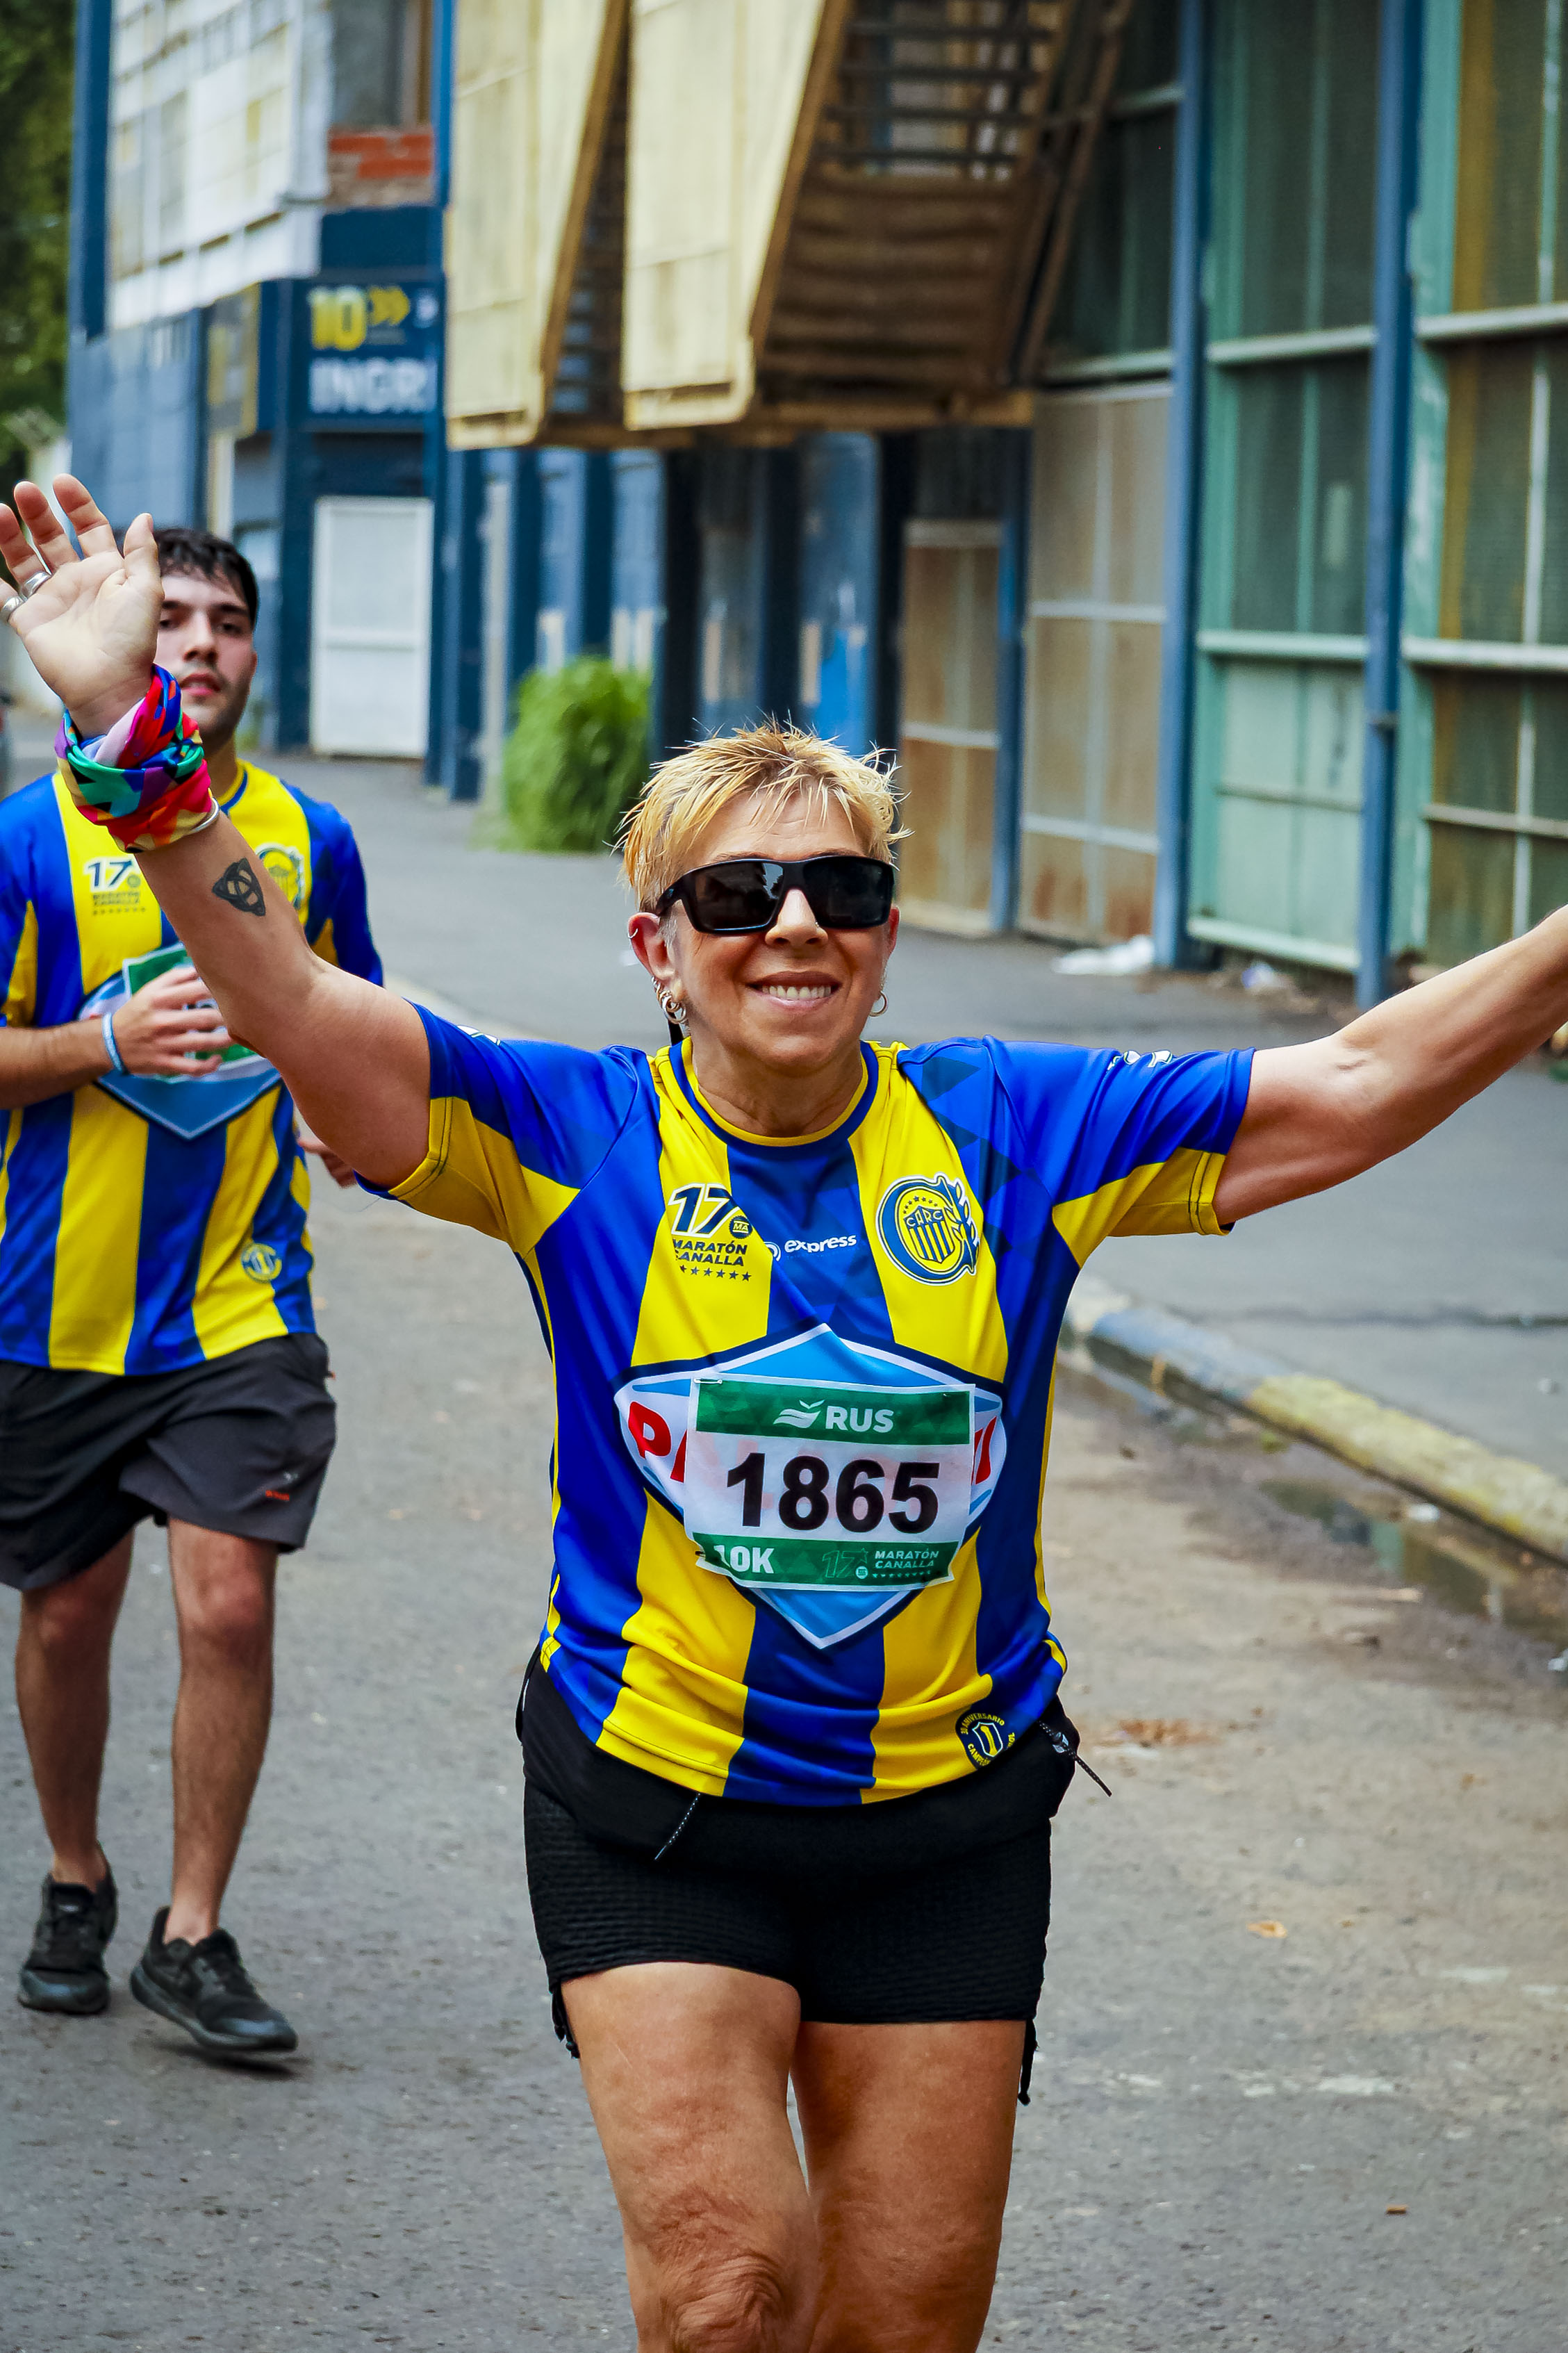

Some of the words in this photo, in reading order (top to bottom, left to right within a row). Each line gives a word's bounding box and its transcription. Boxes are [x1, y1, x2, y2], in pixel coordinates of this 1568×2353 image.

[309, 286, 367, 350] 10
[85, 857, 139, 891] 17
[668, 1183, 741, 1238] 17
[905, 1208, 943, 1227] CARC
[672, 1239, 748, 1255] MARATÓN
[784, 1234, 857, 1253] express
[825, 1405, 894, 1434] RUS
[726, 1452, 941, 1534] 1865
[874, 1548, 939, 1559] MARATÓN
[874, 1559, 935, 1569] CANALLA
